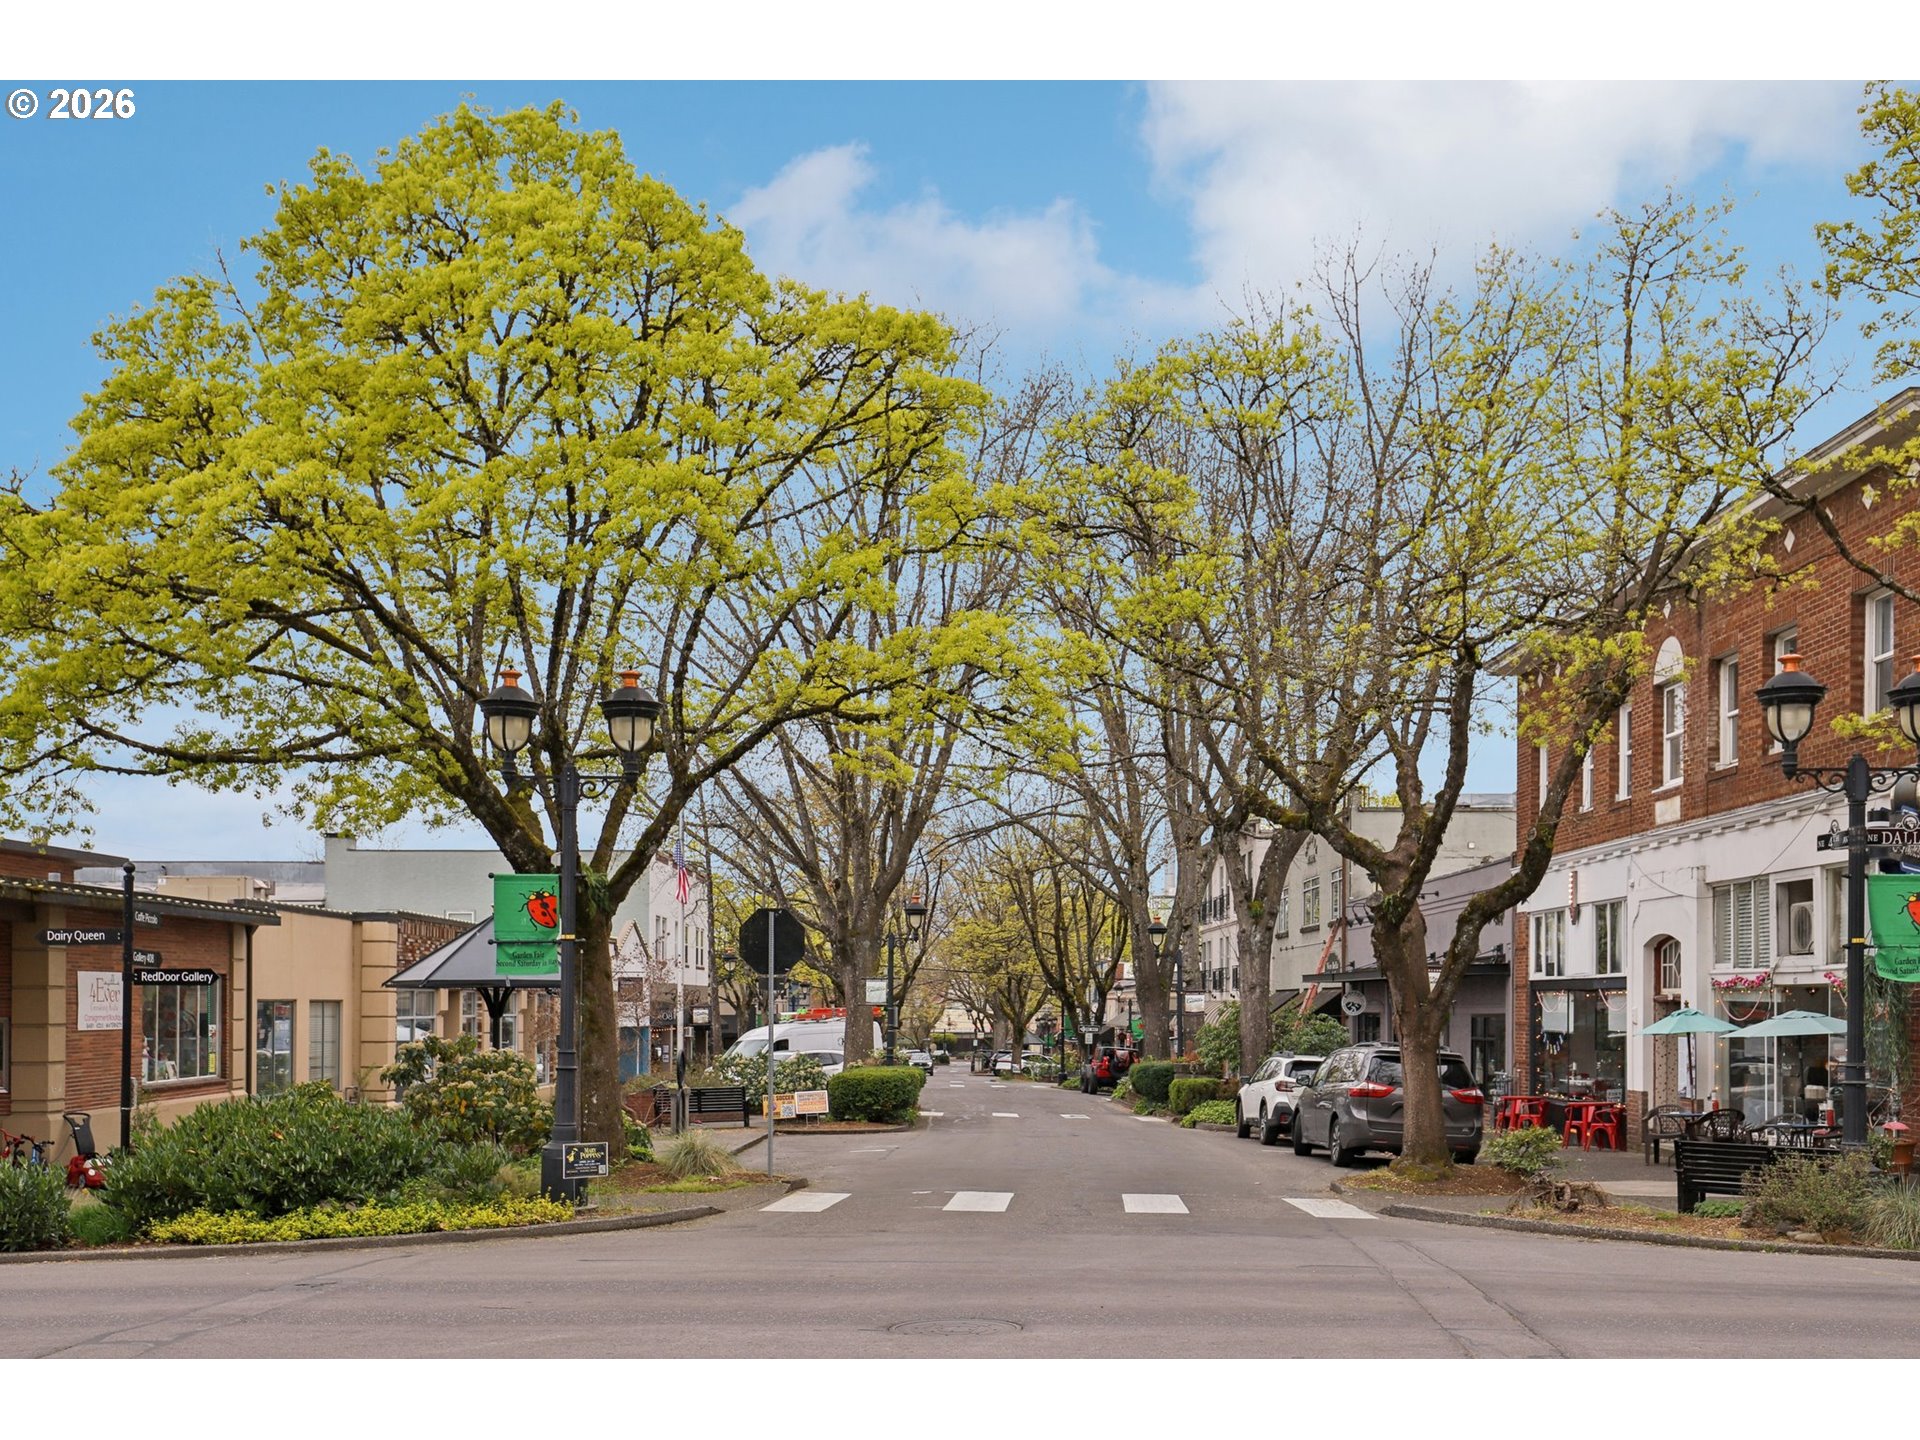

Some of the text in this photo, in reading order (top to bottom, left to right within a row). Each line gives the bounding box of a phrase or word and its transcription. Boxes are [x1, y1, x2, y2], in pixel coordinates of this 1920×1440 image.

[1867, 834, 1879, 842] NE
[47, 930, 106, 943] Dairy Queen
[512, 951, 533, 959] Garden
[496, 959, 516, 967] Second
[517, 960, 541, 969] Saturday
[1894, 956, 1917, 965] Garden
[141, 971, 213, 984] RedDoor Gallery
